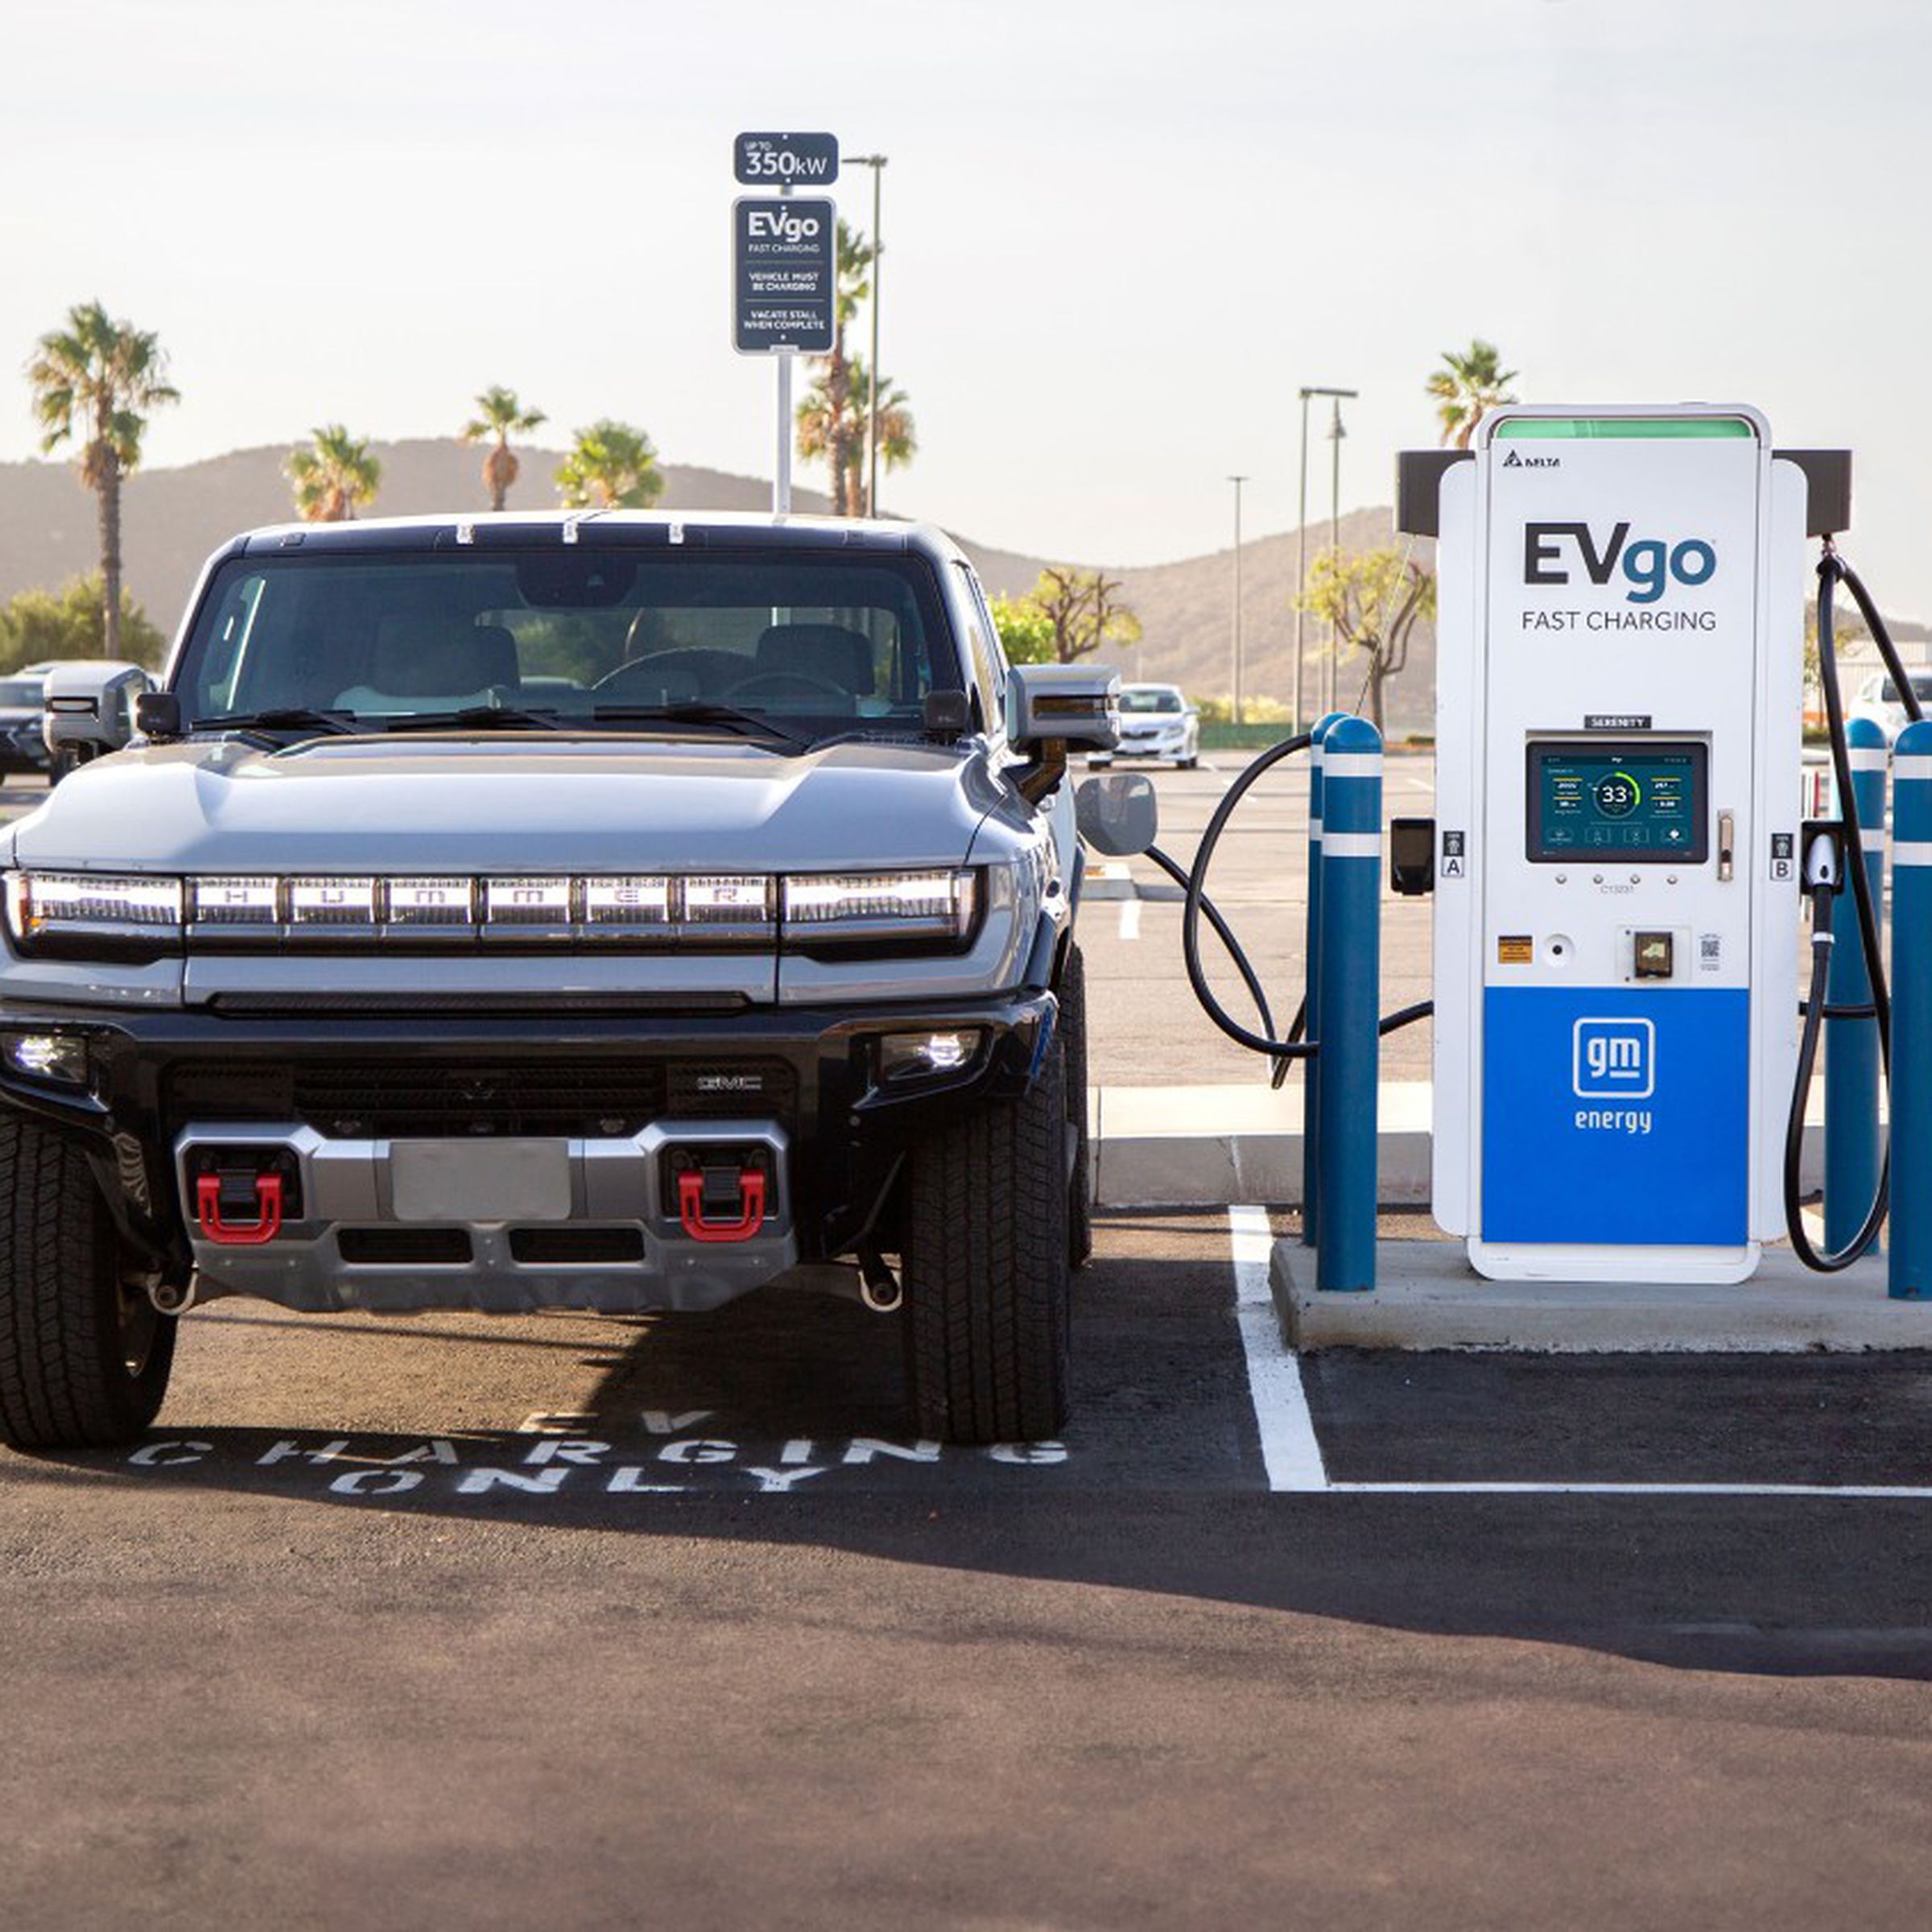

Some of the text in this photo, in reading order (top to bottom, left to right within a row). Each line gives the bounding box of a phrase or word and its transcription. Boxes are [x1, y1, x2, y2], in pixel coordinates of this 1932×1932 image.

[749, 212, 819, 242] EVgo
[749, 244, 820, 254] FAST CHARGING
[749, 272, 819, 281] VEHICLE MUST
[766, 283, 816, 291] CHARGING
[750, 310, 817, 319] VACATE STALL
[744, 320, 825, 329] WHEN COMPLETE
[1525, 522, 1716, 604] EVgo
[1522, 611, 1716, 631] FAST CHARGING
[1447, 859, 1459, 873] A
[1776, 861, 1789, 877] B
[1587, 1038, 1641, 1078] gm
[697, 1076, 762, 1090] GMC
[1575, 1111, 1651, 1133] energy
[515, 1410, 715, 1435] EV
[126, 1439, 1069, 1466] CHARGING
[328, 1467, 829, 1495] ONLY
